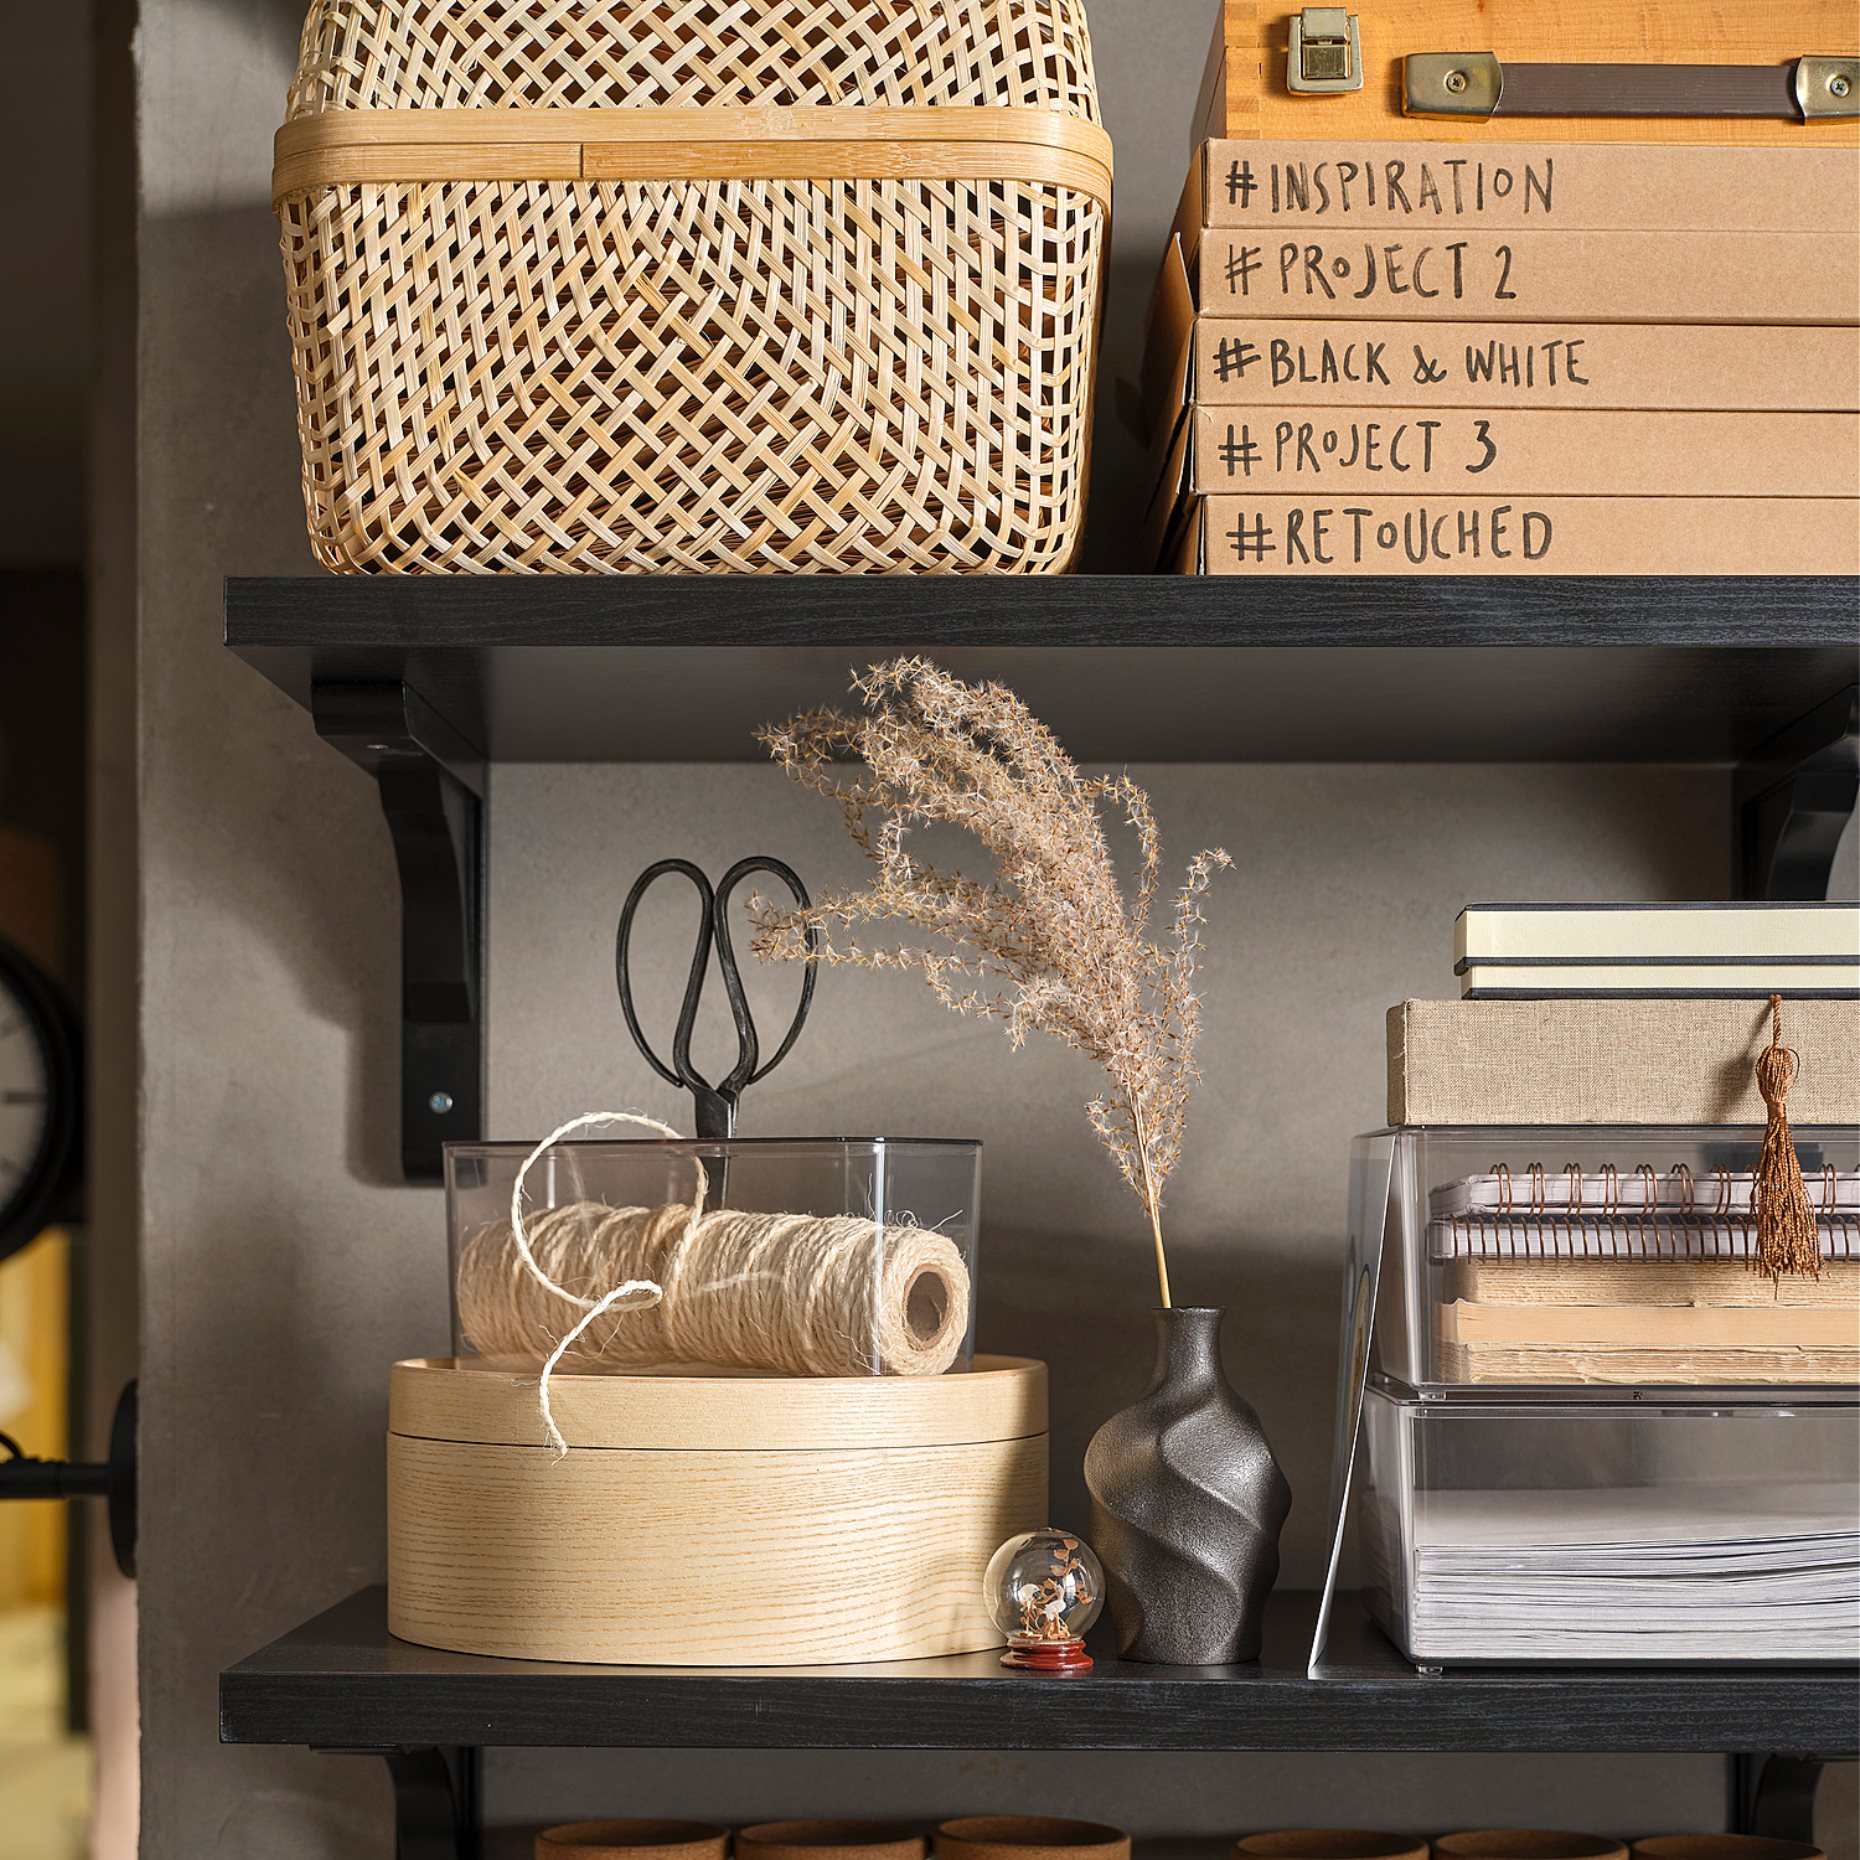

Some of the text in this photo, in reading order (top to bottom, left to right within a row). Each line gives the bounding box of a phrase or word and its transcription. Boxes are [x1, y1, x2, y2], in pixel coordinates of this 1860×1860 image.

[1494, 244, 1518, 301] 2
[1413, 345, 1448, 385] &
[1466, 339, 1589, 388] WHITE
[1465, 420, 1498, 475] 3
